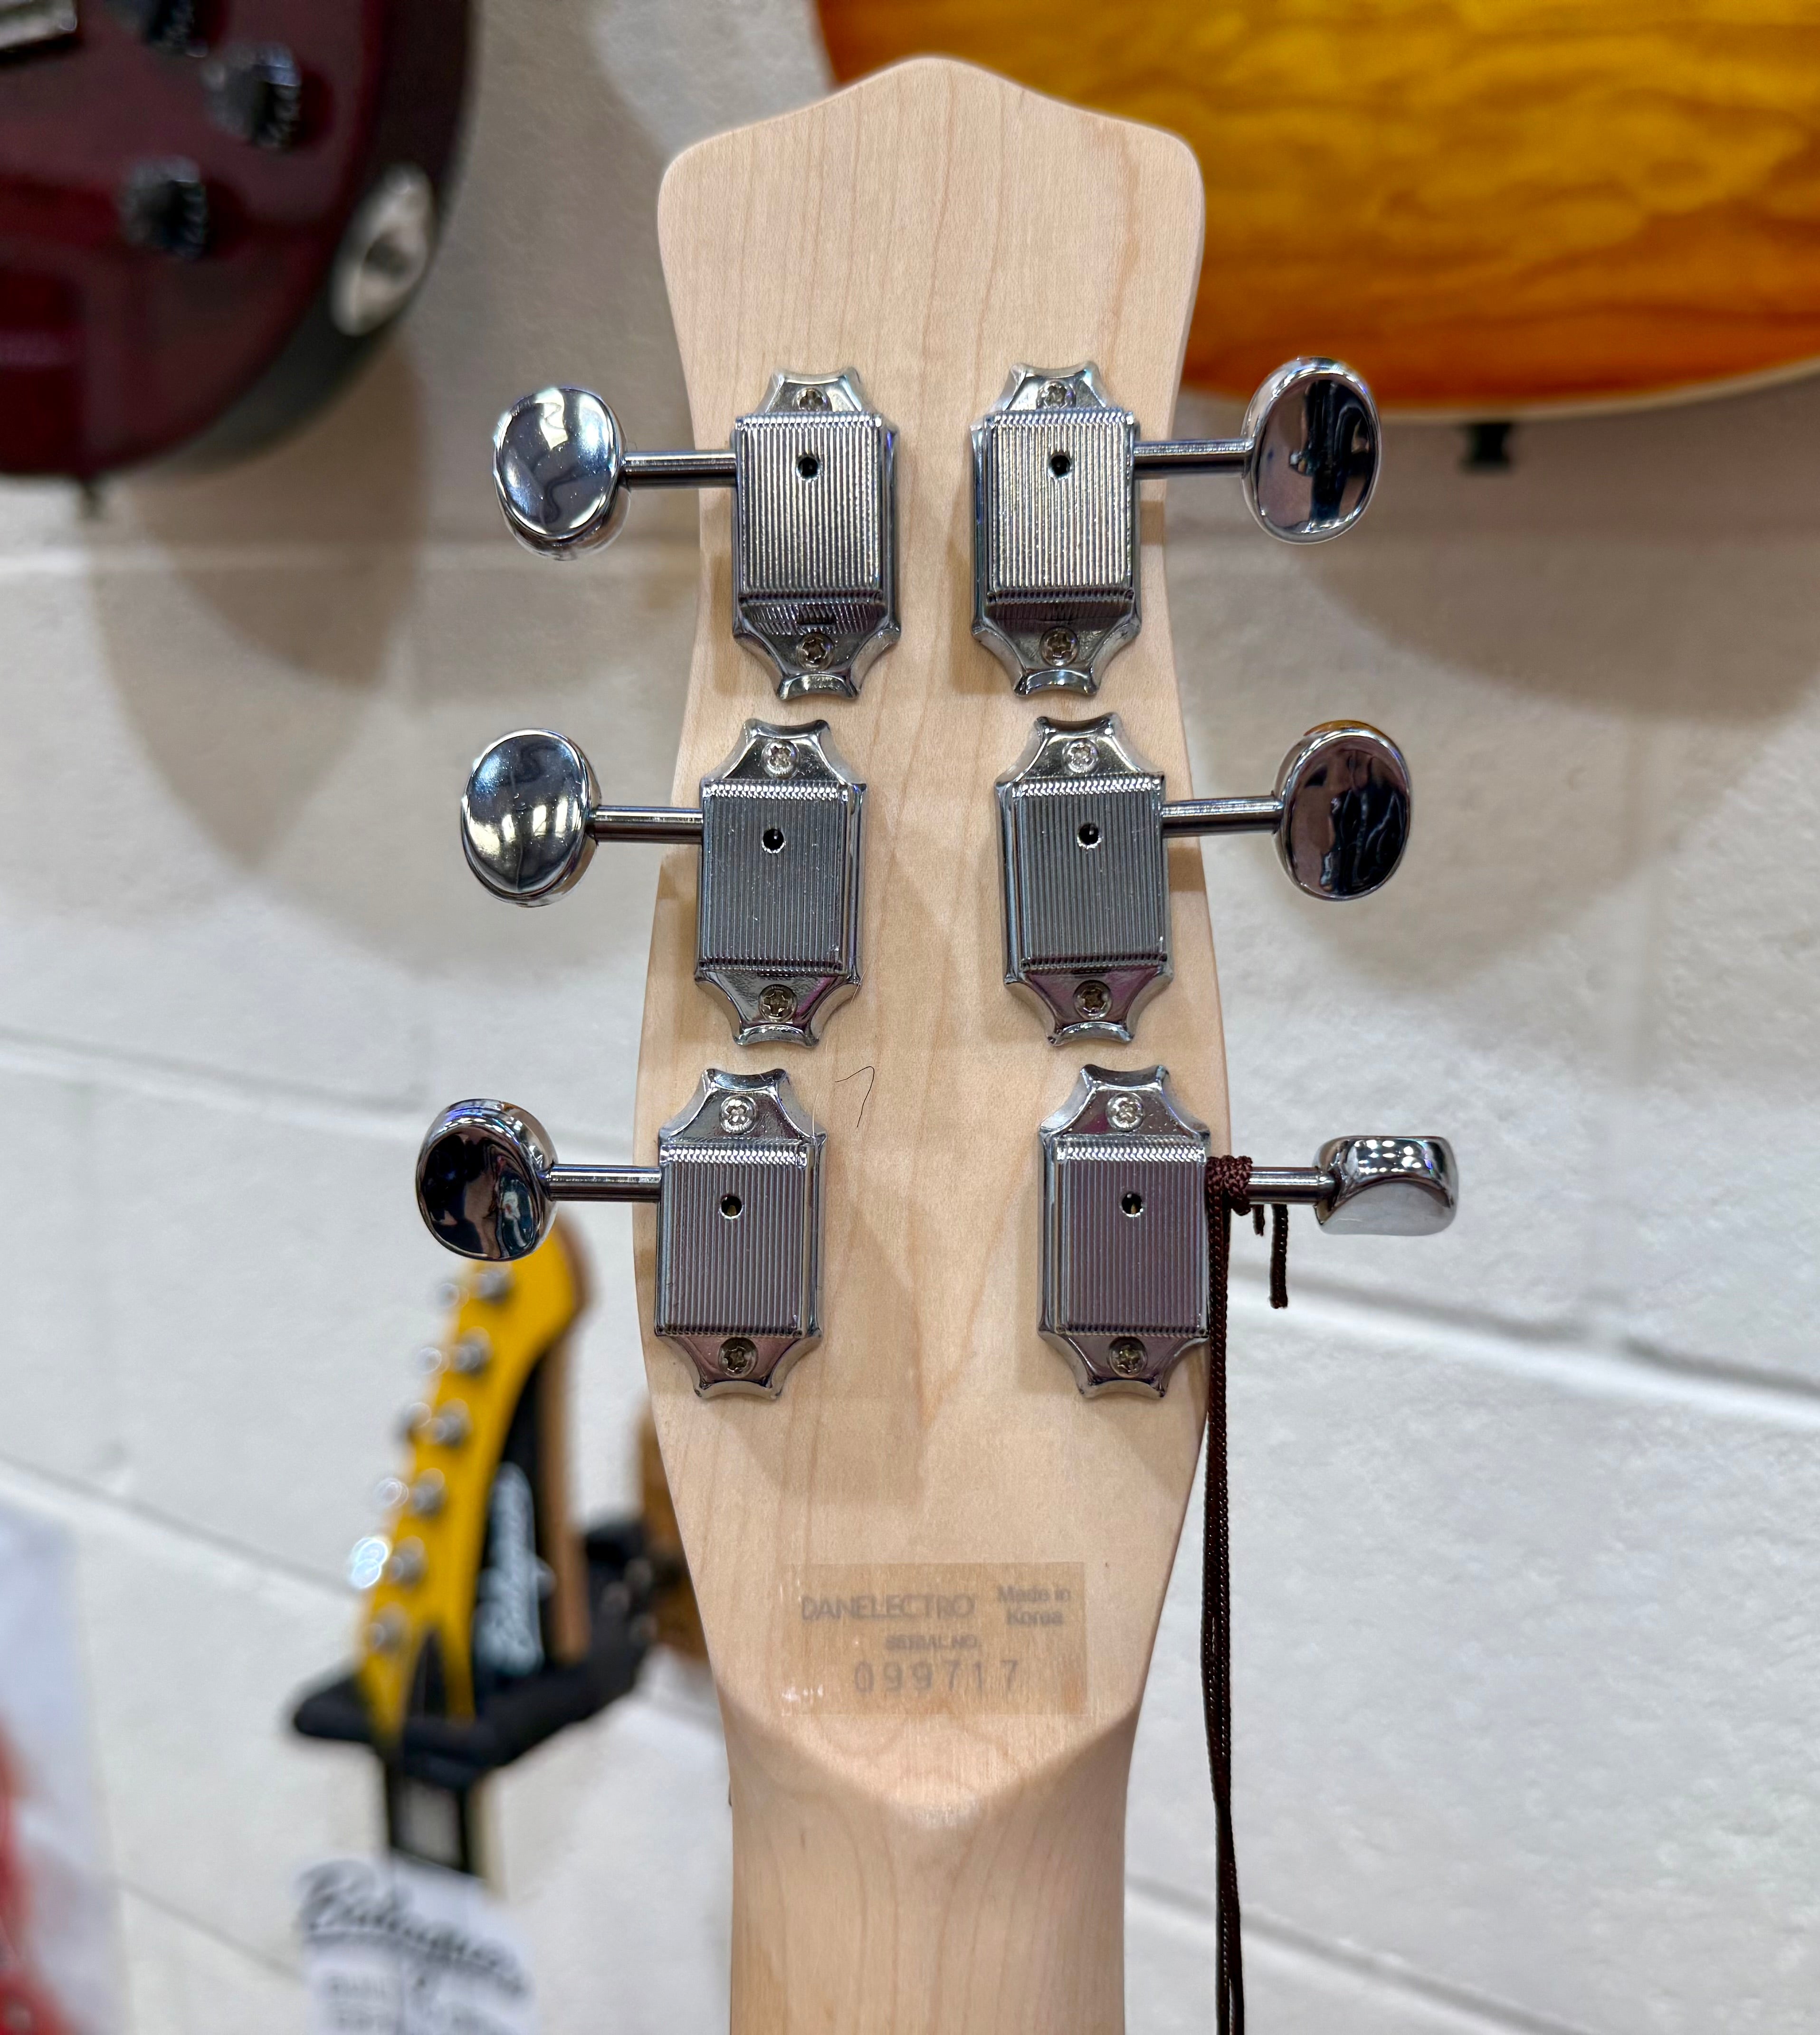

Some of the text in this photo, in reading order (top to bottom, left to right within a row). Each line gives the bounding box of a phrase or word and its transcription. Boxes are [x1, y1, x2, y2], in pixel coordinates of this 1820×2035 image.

[997, 1584, 1071, 1602] Made in
[801, 1593, 976, 1620] DANELECTRO
[1007, 1608, 1063, 1626] Korea
[854, 1659, 1019, 1693] 099717
